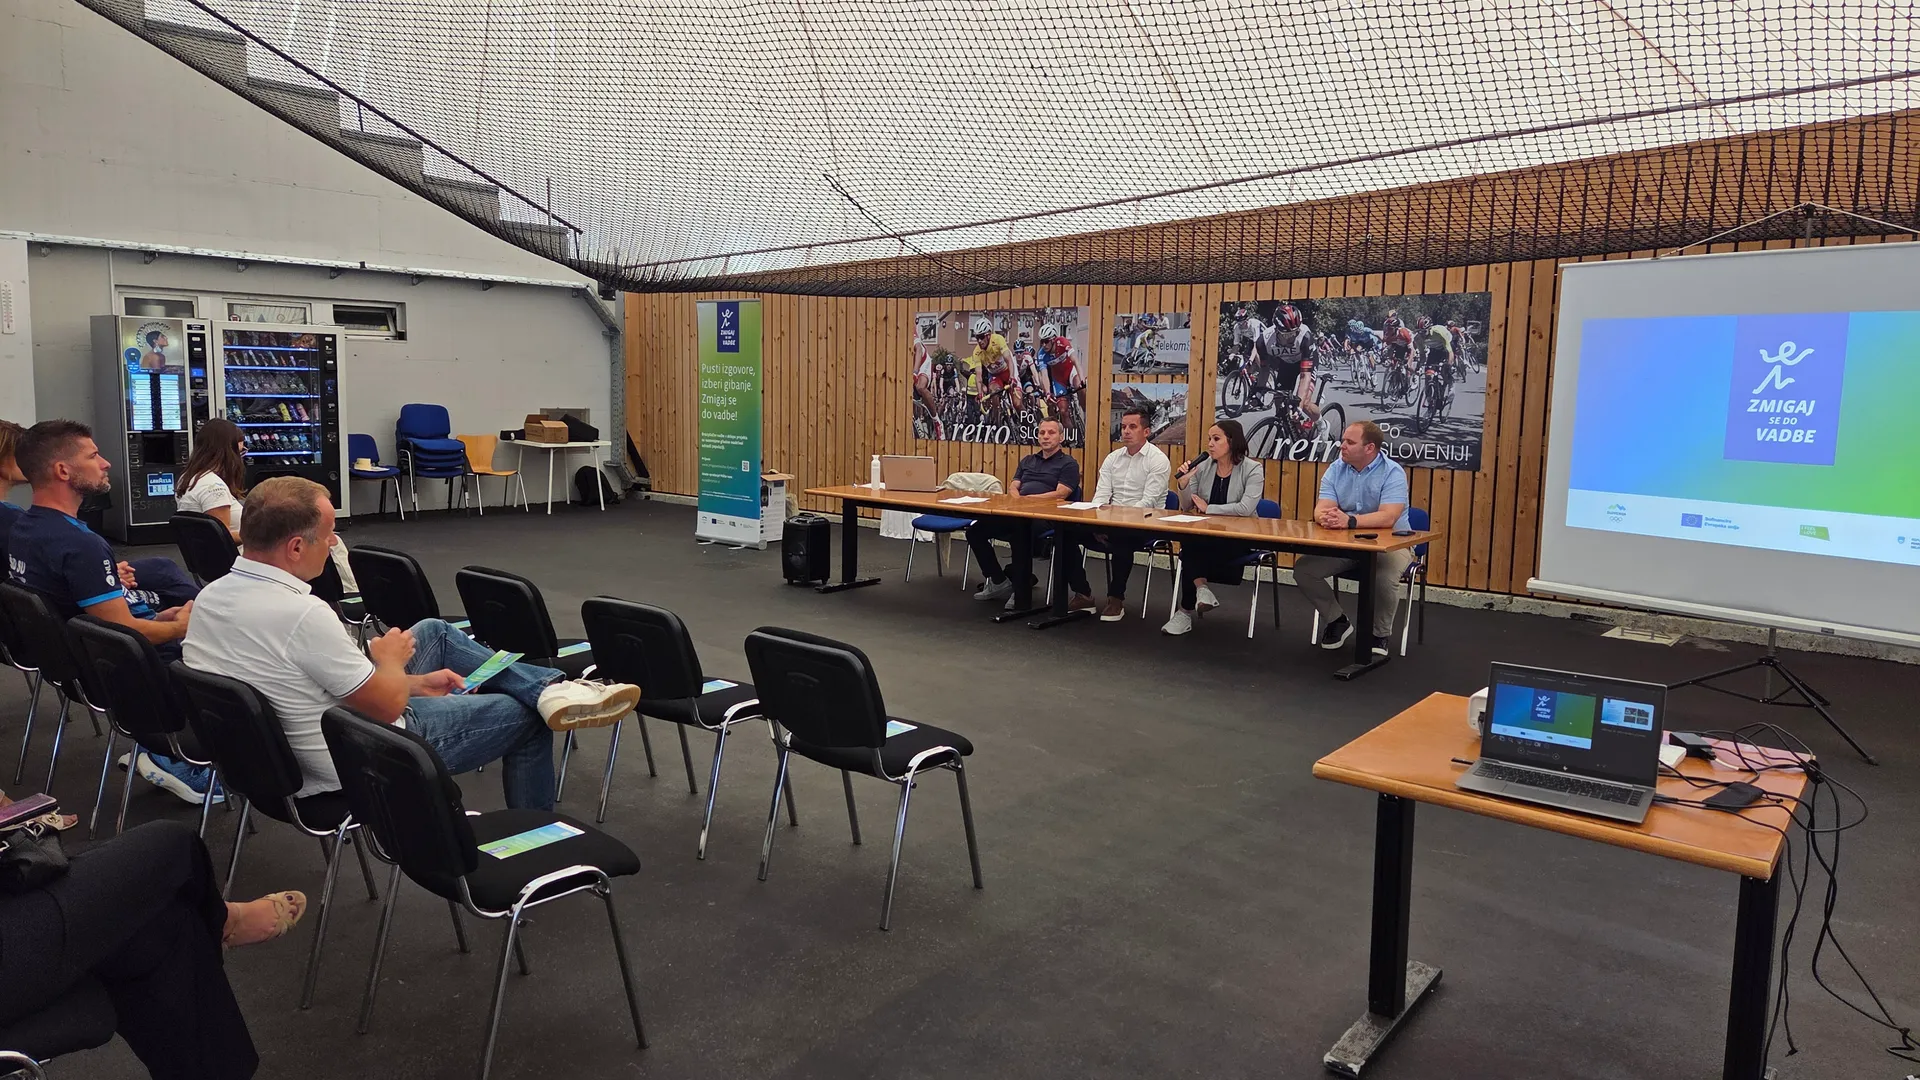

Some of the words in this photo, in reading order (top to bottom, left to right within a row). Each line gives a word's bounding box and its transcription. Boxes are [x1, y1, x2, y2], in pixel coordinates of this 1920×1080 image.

[1271, 347, 1297, 356] UAE
[701, 363, 721, 374] Pusti
[722, 364, 756, 377] izgovore,
[701, 378, 723, 389] izberi
[724, 380, 753, 392] gibanje.
[701, 393, 727, 407] Zmigaj
[728, 396, 737, 406] se
[701, 408, 712, 419] do
[713, 409, 738, 421] vadbe!
[1747, 399, 1816, 417] ZMIGAJ
[1020, 410, 1035, 424] Po
[1768, 416, 1781, 425] SE
[1782, 416, 1798, 426] DO
[952, 421, 1011, 445] retro
[1379, 422, 1400, 439] Po
[1755, 427, 1817, 444] VADBE
[1272, 434, 1341, 463] retr
[103, 559, 112, 575] NLB
